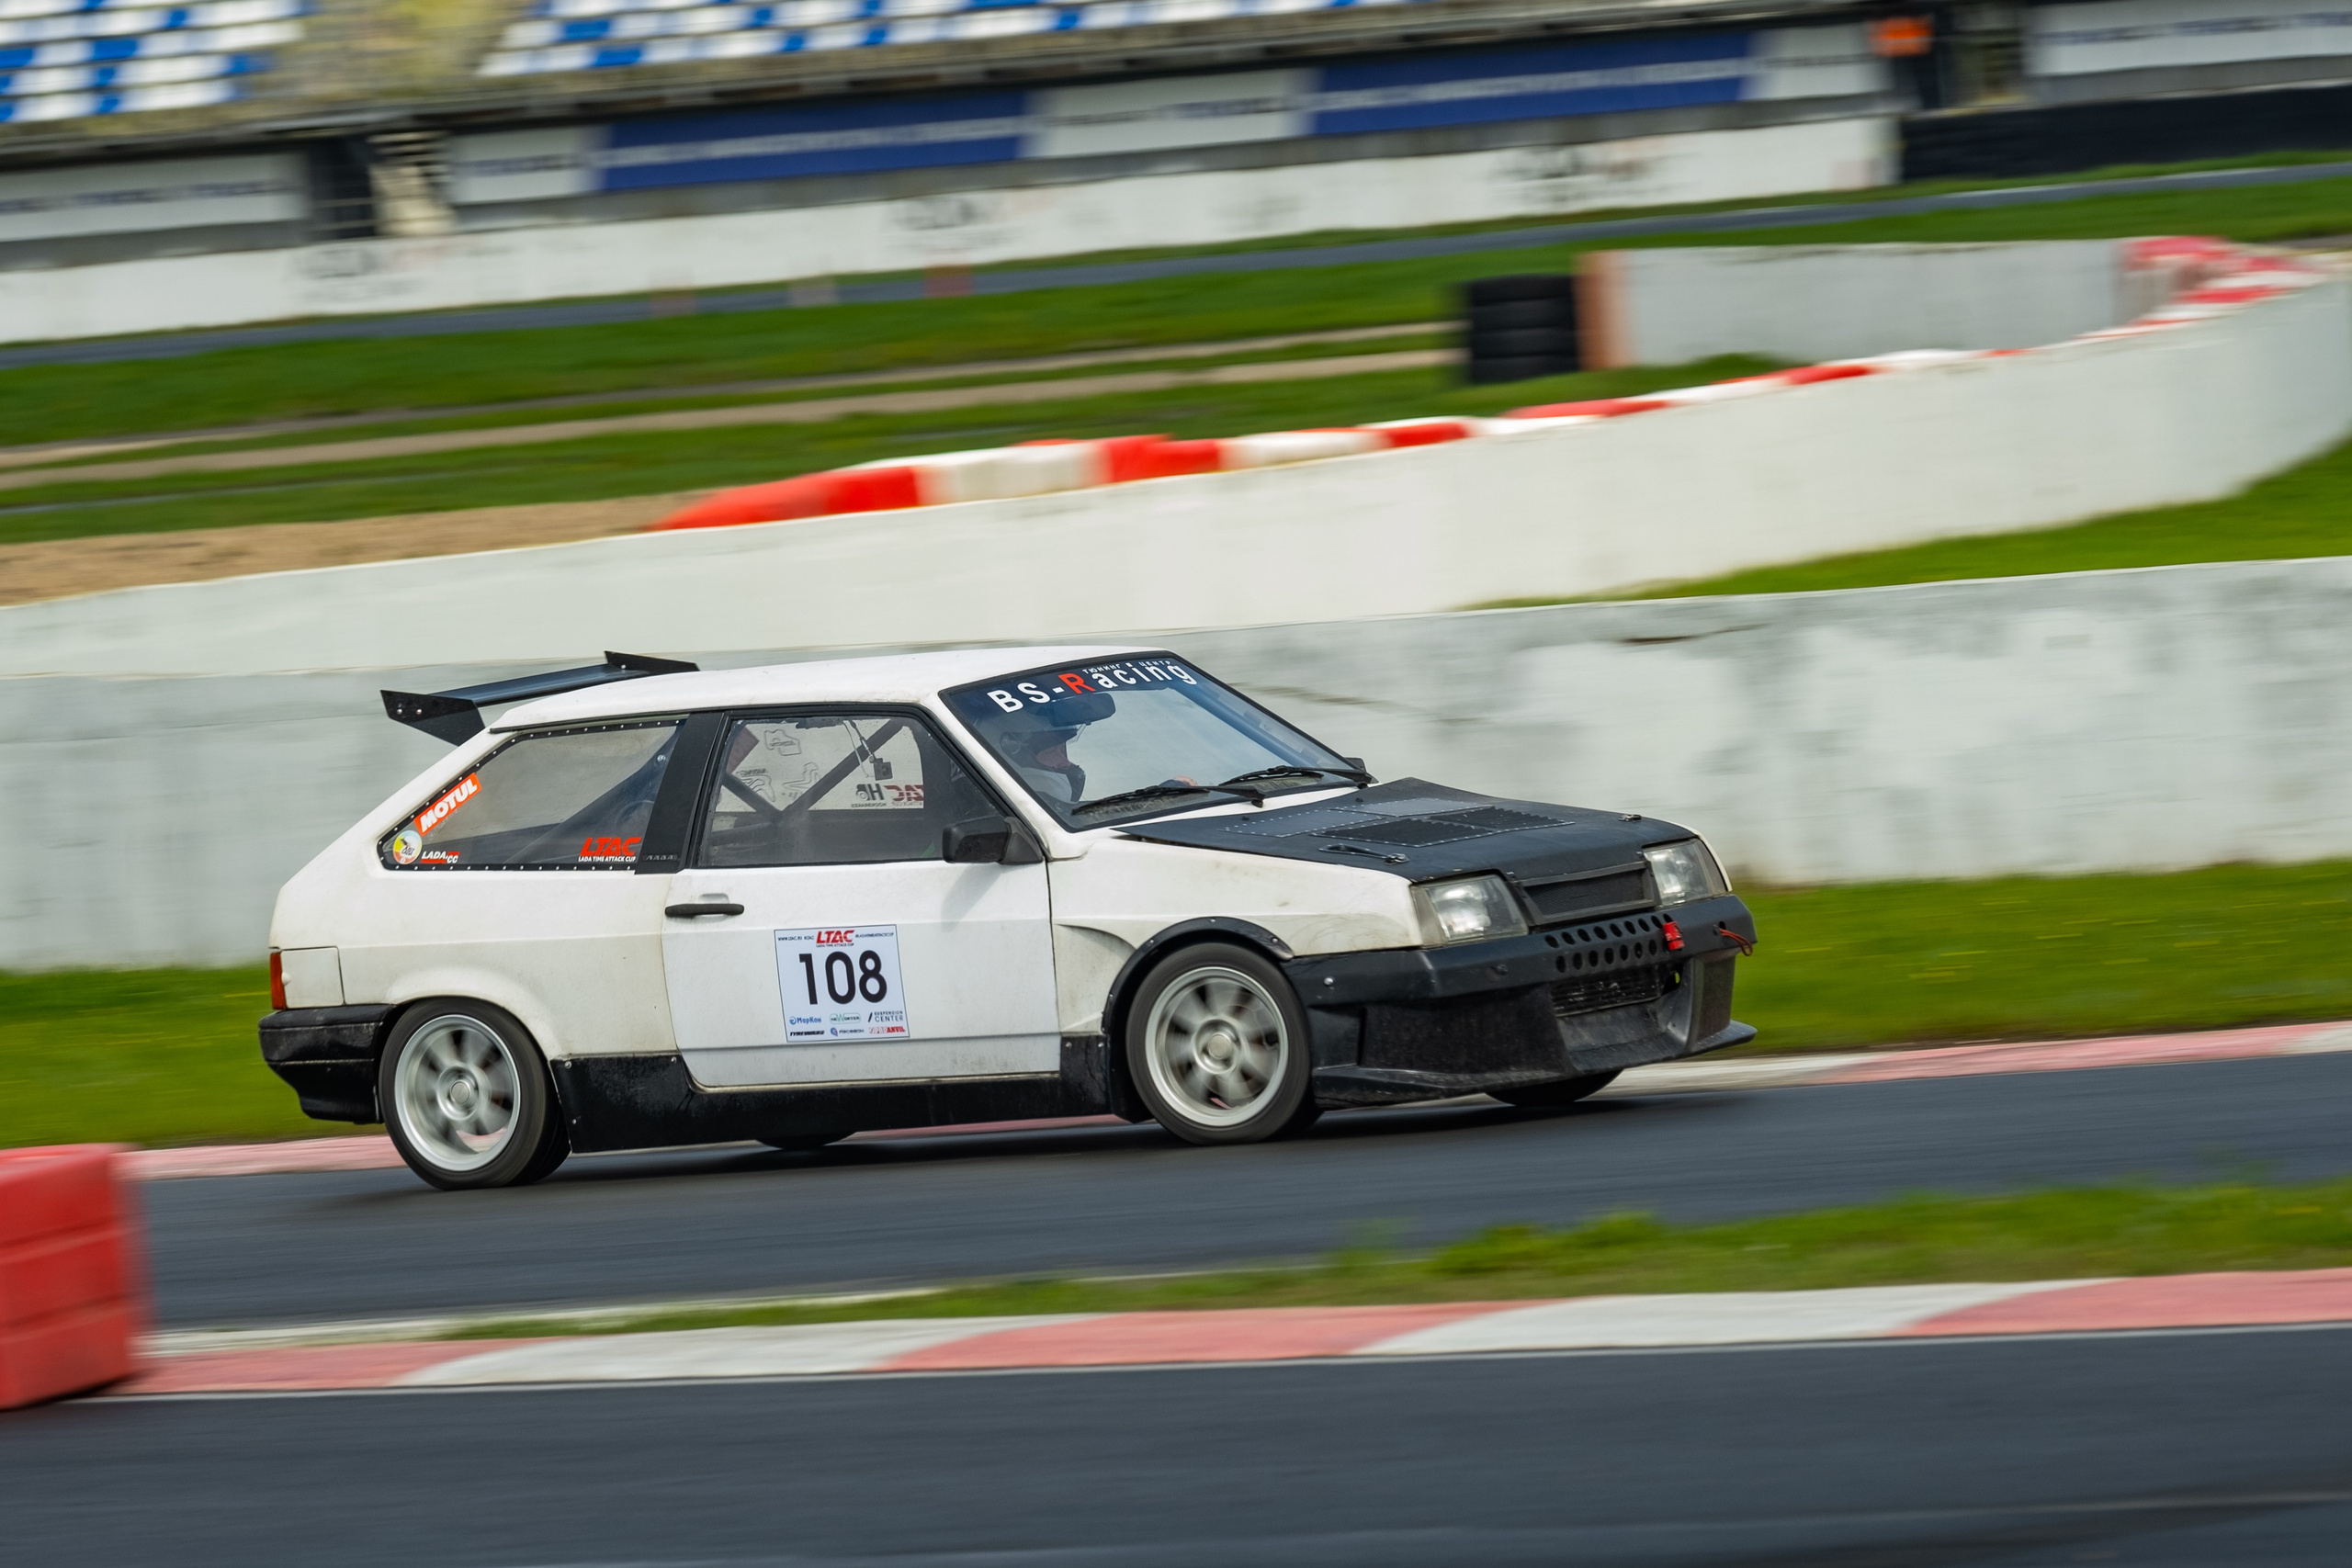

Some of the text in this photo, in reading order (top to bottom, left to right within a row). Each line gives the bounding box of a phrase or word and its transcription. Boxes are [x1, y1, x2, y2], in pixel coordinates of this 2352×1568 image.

[1082, 663, 1121, 674] ТЮНИНГ
[987, 662, 1198, 713] BS-Racing
[420, 778, 478, 833] MOTUL
[580, 837, 642, 856] LTAC
[816, 930, 854, 943] LTAC
[798, 950, 888, 1005] 108
[874, 1015, 904, 1023] CENTER
